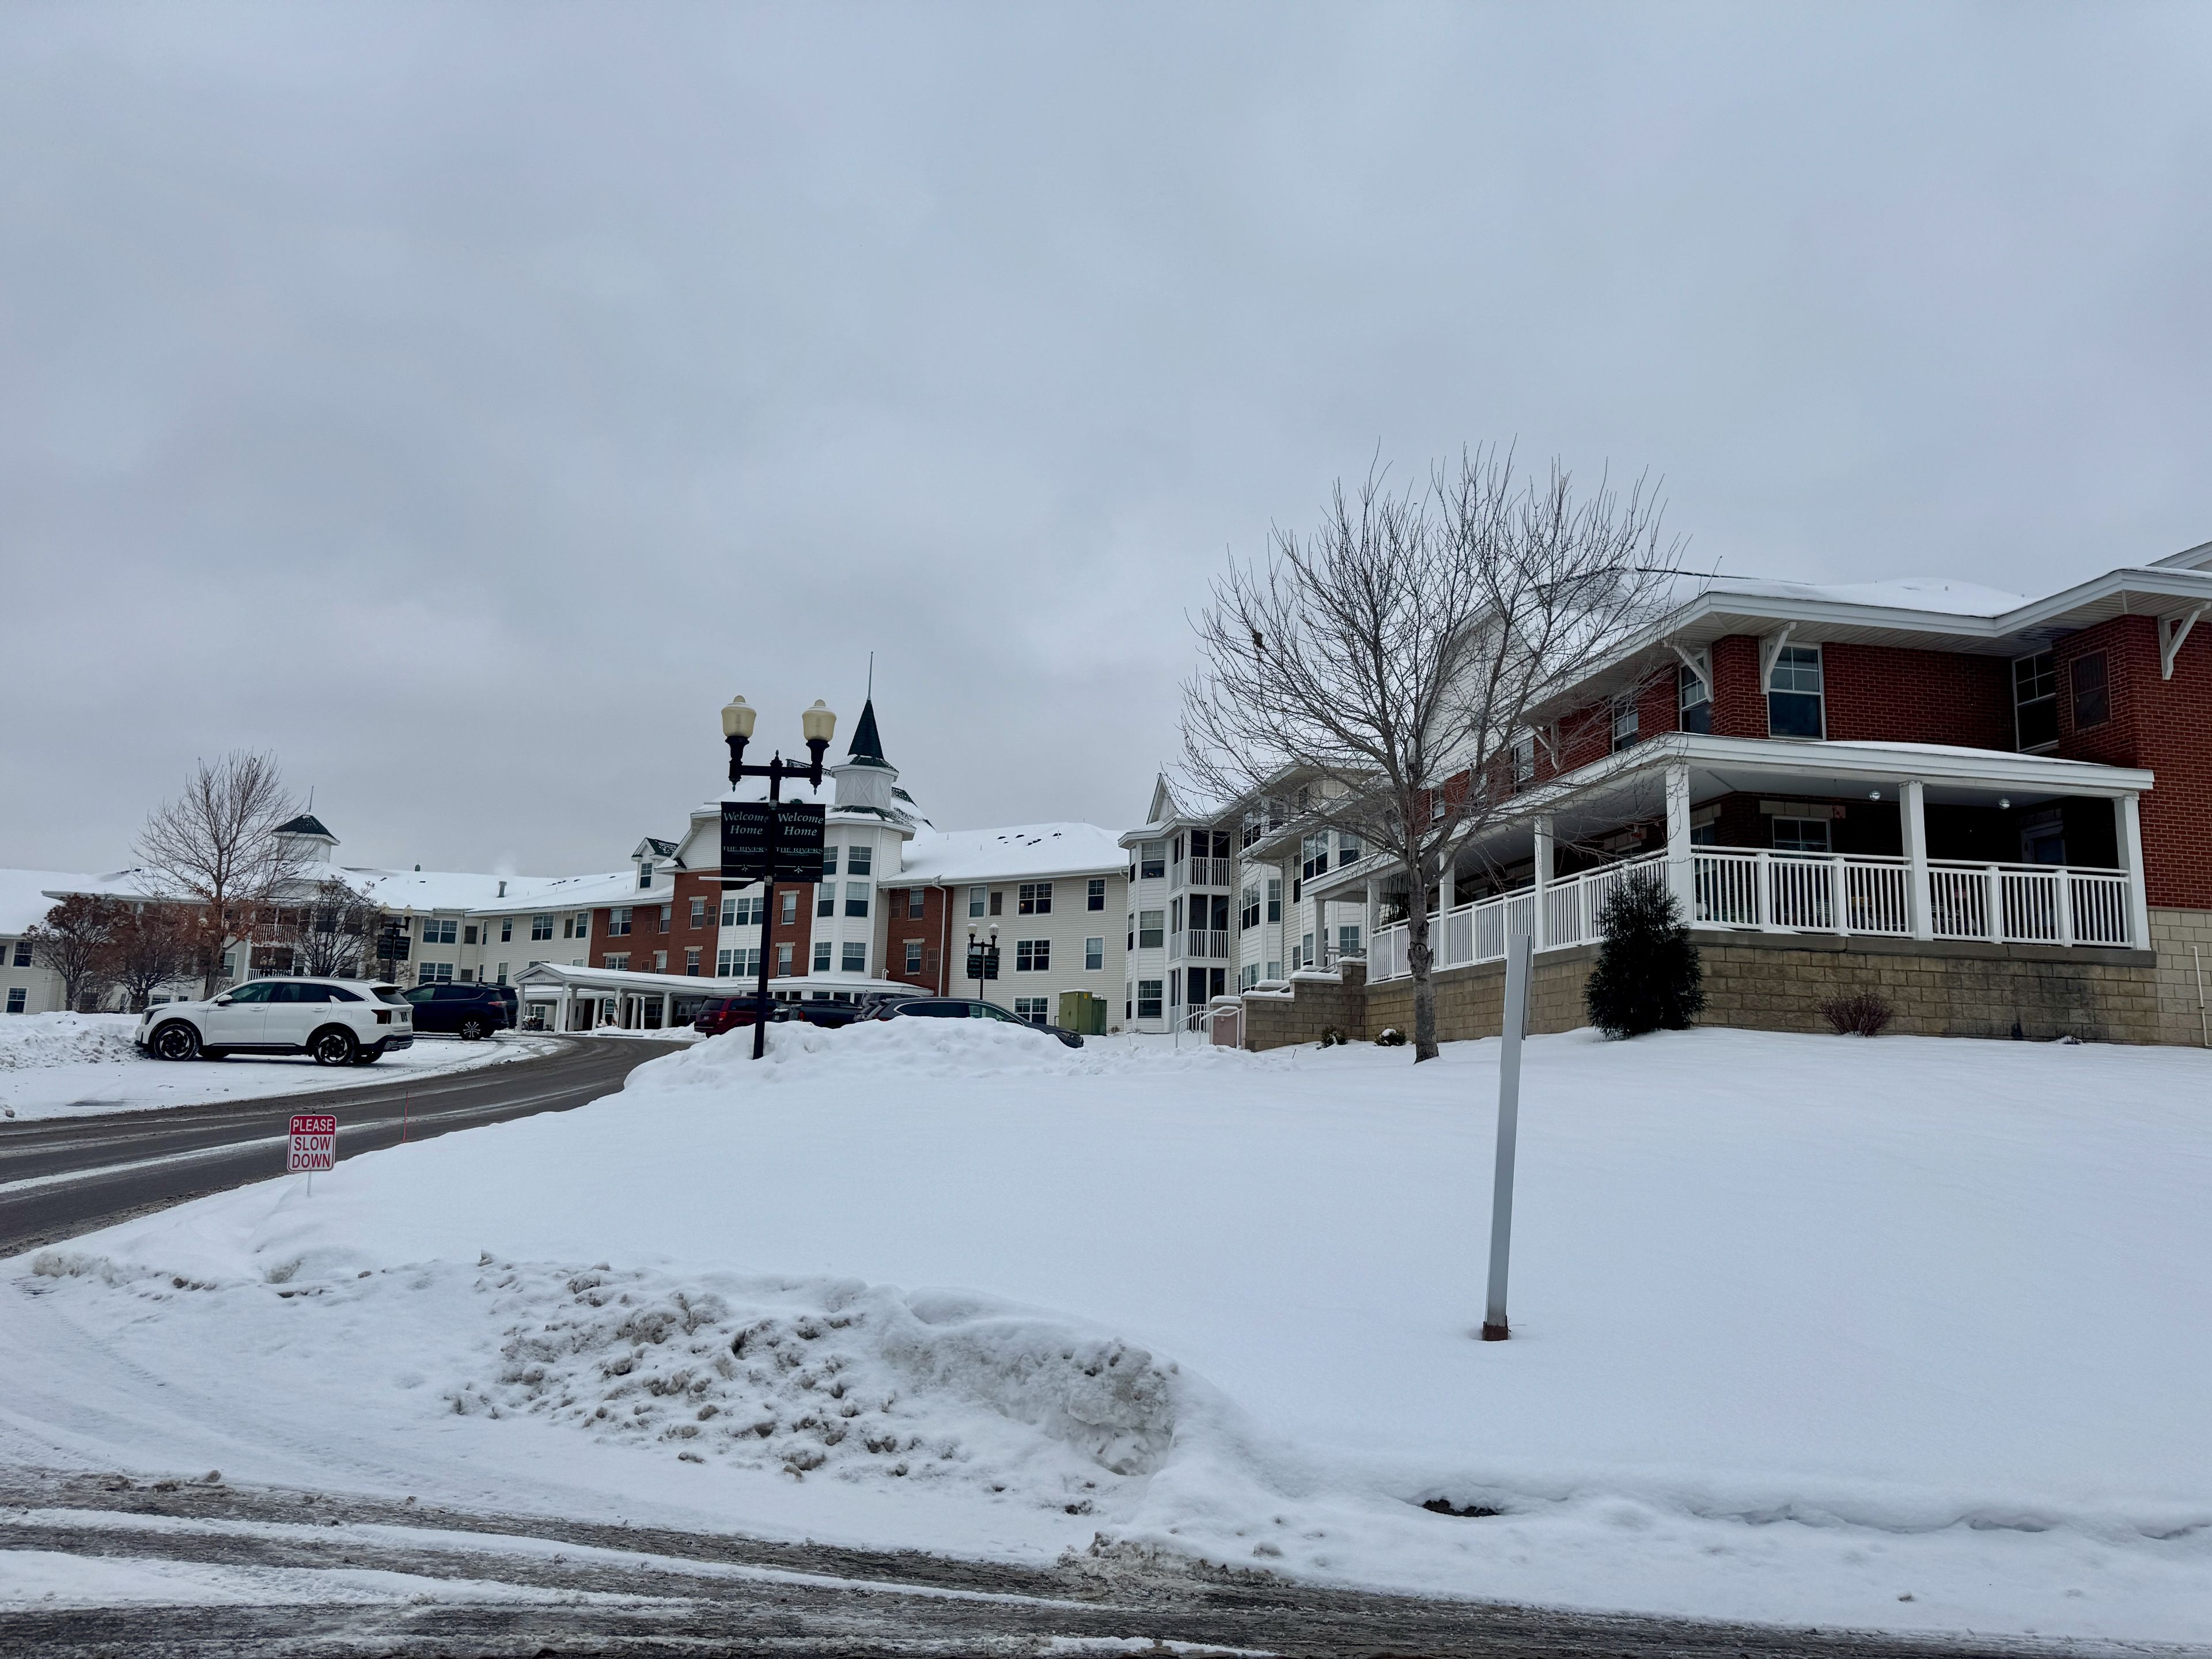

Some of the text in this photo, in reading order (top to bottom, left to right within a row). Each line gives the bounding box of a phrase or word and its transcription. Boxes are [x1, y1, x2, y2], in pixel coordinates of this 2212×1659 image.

[723, 811, 769, 823] Welcome
[778, 812, 824, 824] Welcome
[729, 825, 763, 835] Home
[783, 826, 817, 836] Home
[293, 1119, 333, 1132] PLEASE
[294, 1137, 331, 1151] SLOW
[292, 1153, 331, 1168] DOWN
